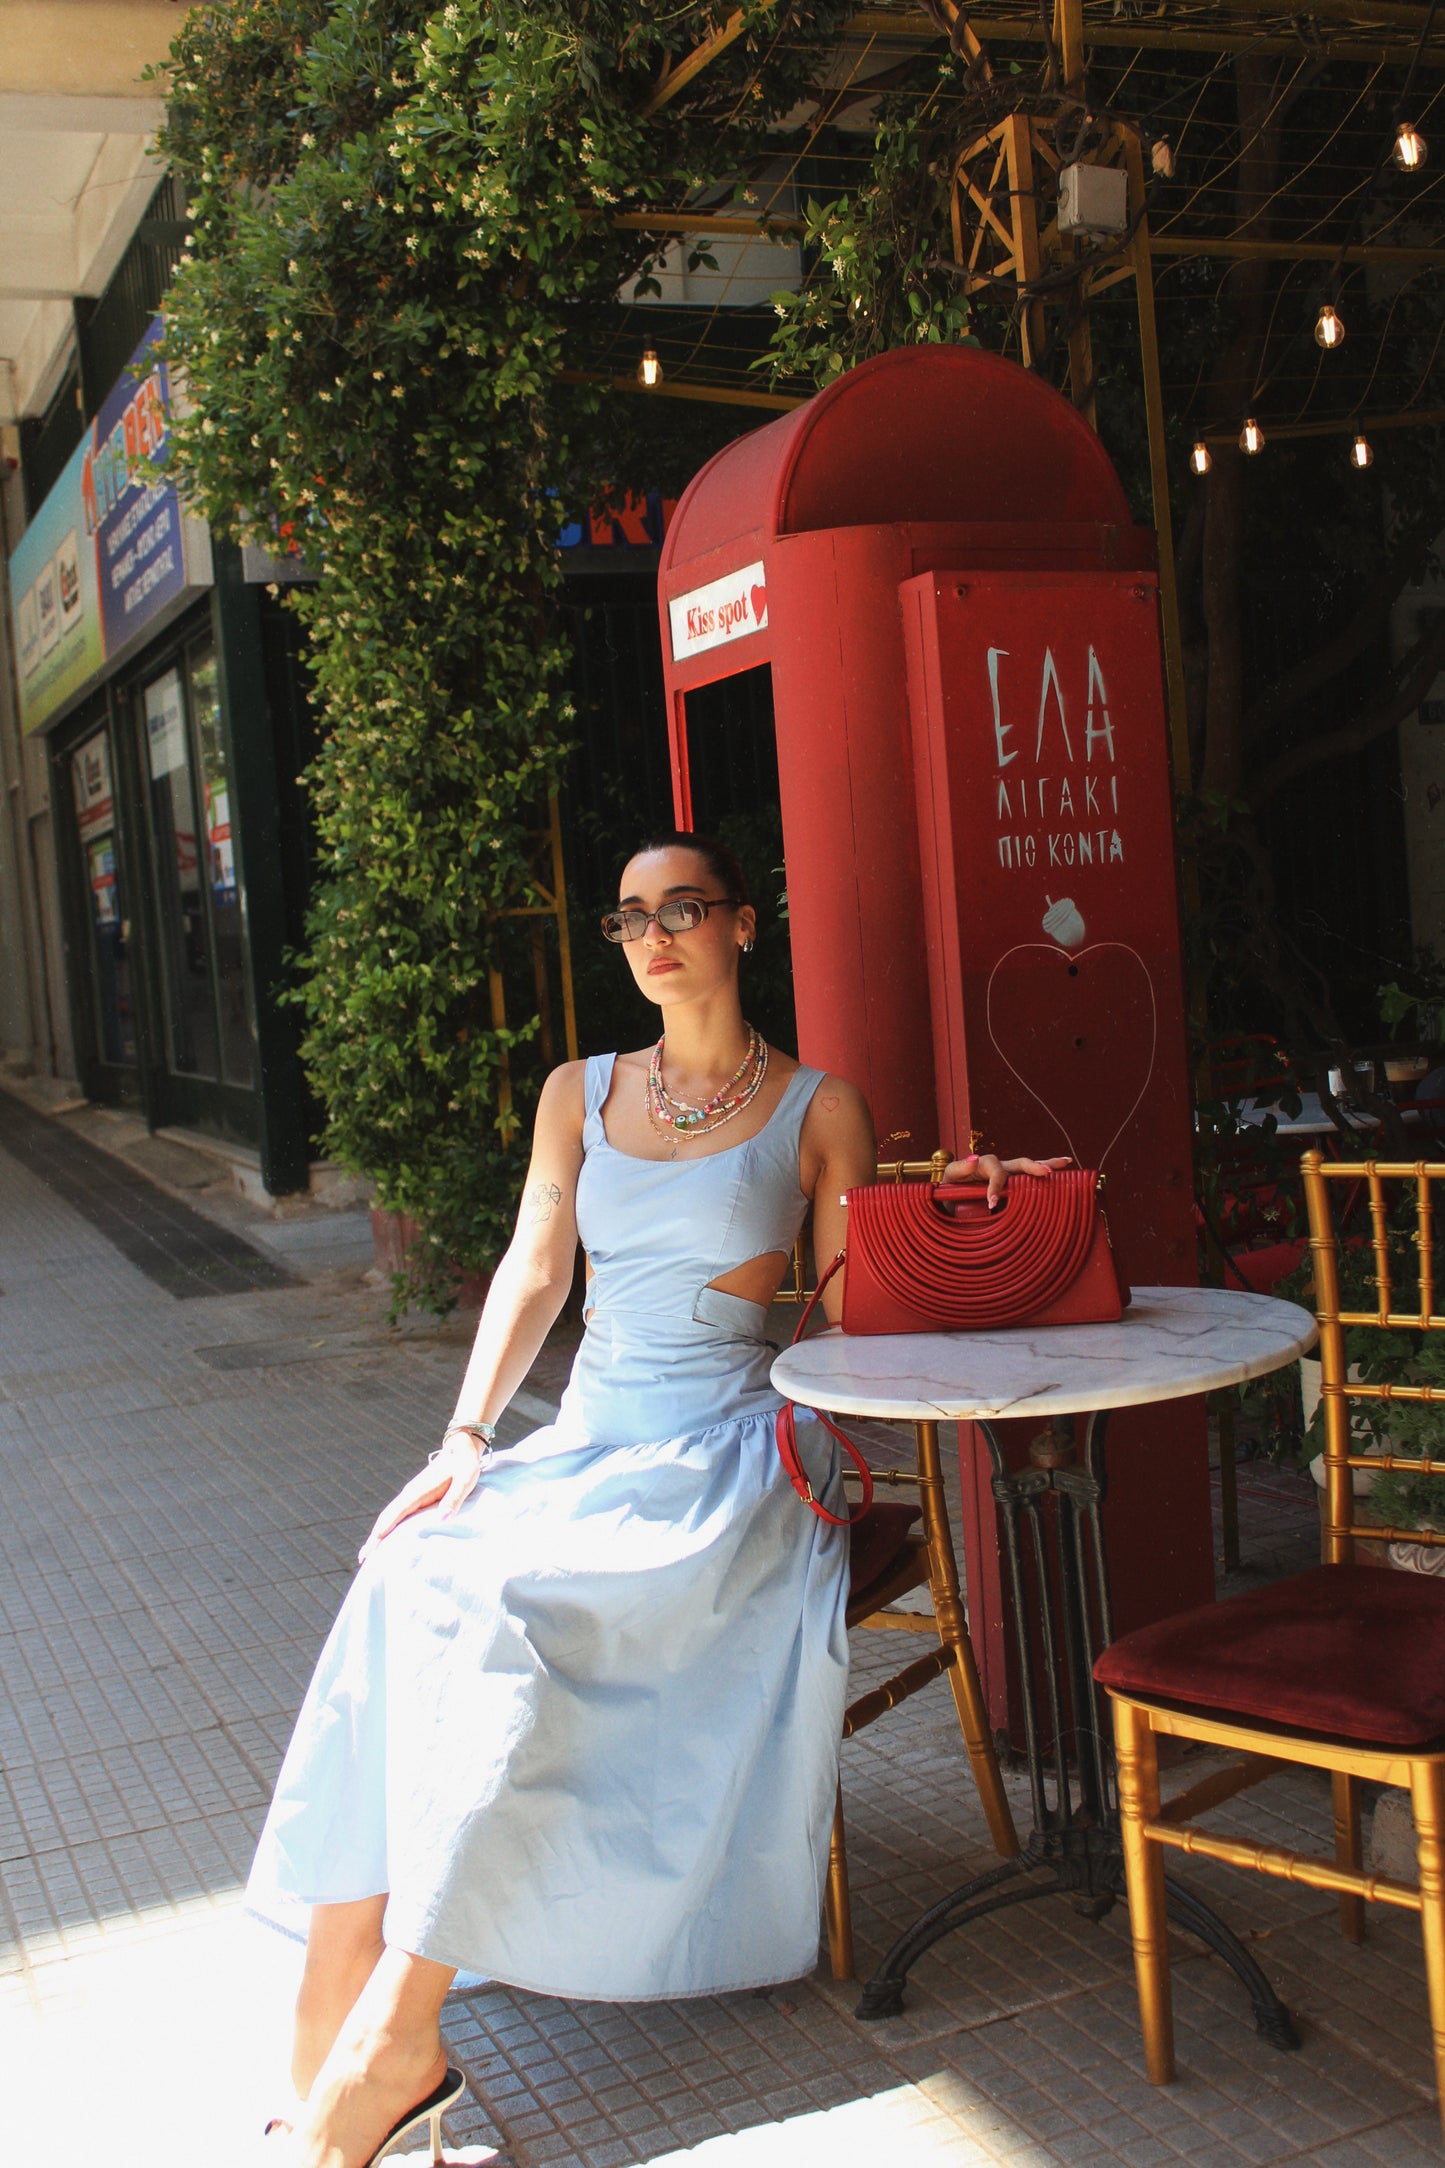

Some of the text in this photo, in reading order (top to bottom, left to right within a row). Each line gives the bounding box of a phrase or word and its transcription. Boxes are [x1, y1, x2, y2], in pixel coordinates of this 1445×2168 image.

[686, 591, 749, 640] Kiss spot
[986, 644, 1116, 767] ΕΛΑ
[998, 775, 1119, 820] ΛΙΓΑΚΙ
[998, 829, 1124, 869] ΠΙΟ ΚΟΝΤΑ
